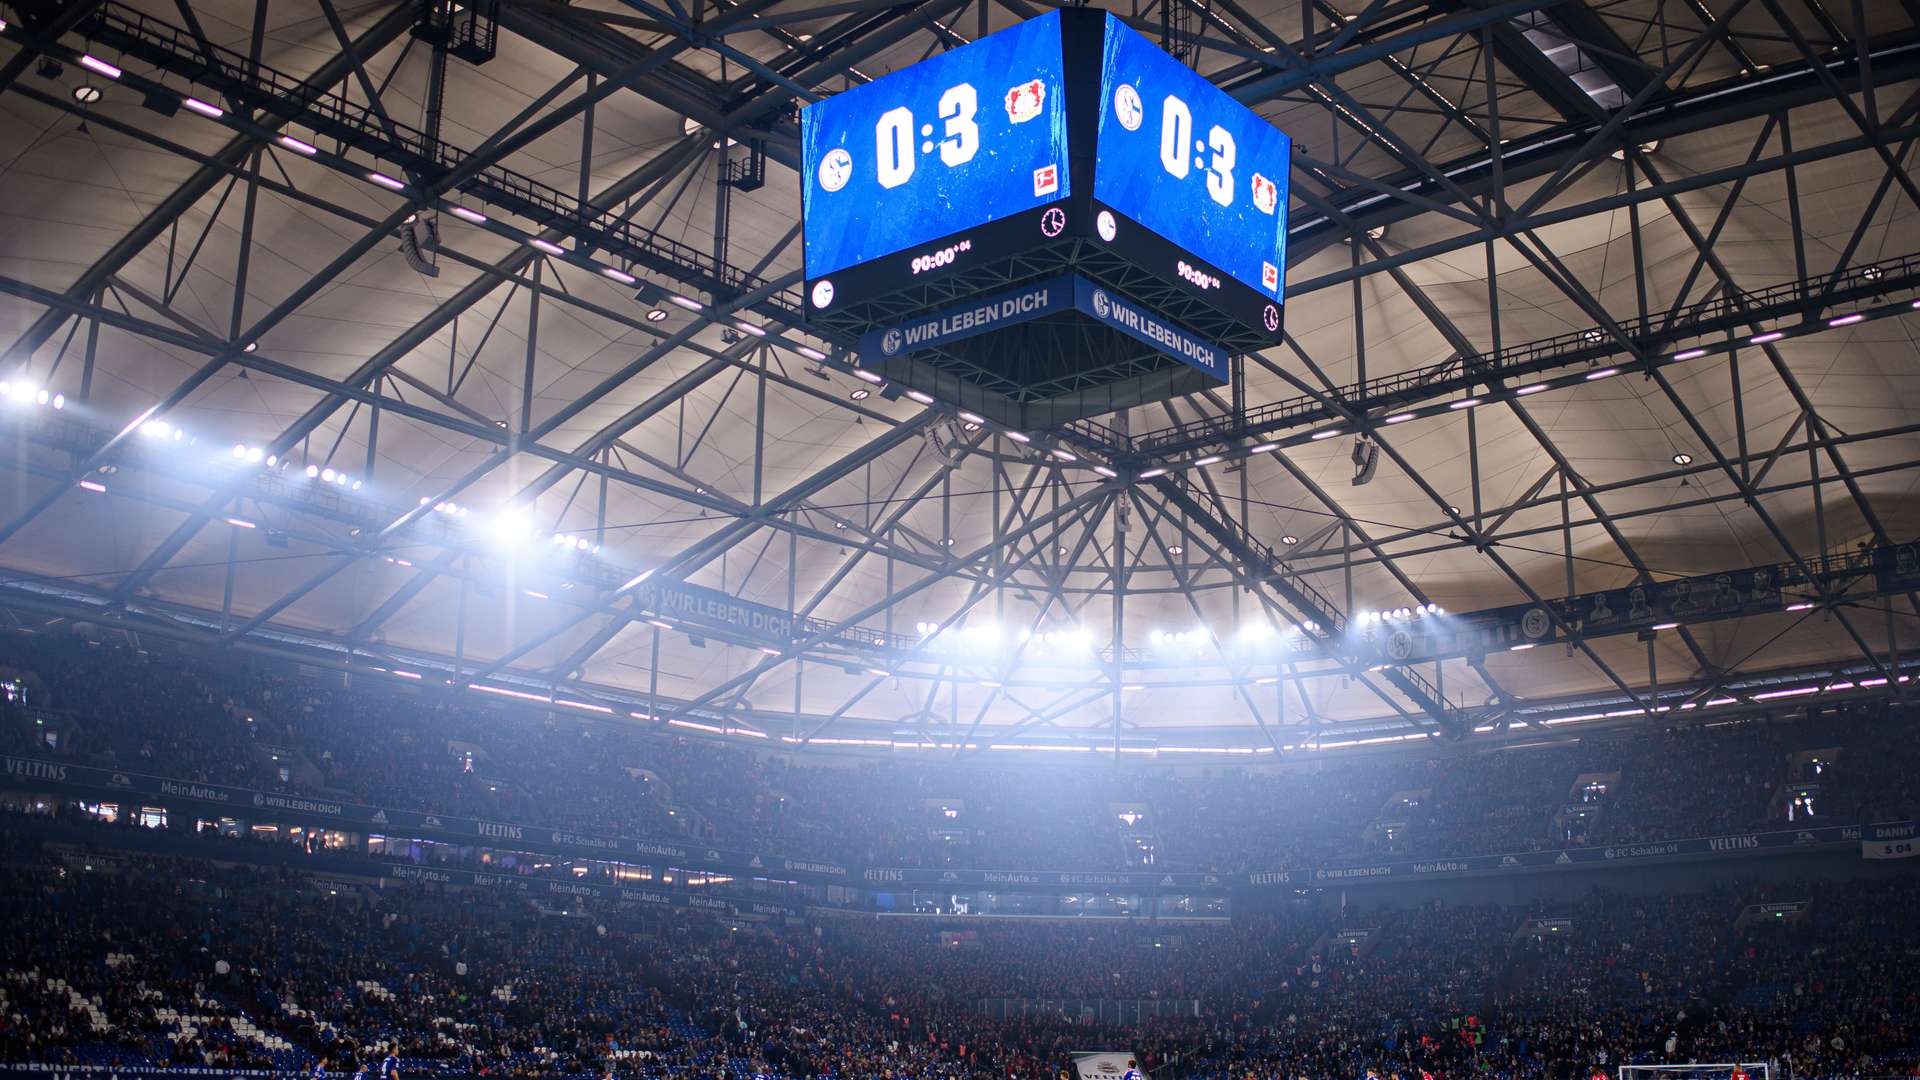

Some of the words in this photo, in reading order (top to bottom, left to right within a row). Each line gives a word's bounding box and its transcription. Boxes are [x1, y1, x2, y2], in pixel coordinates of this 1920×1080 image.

[905, 321, 939, 345] WIR
[942, 303, 999, 335] LEBEN
[1002, 289, 1048, 318] DICH
[1111, 301, 1138, 330] WIR
[1140, 316, 1181, 352] LEBEN
[1183, 338, 1214, 368] DICH
[660, 587, 695, 614] WIR
[697, 596, 750, 626] LEBEN
[752, 611, 791, 636] DICH
[6, 758, 67, 781] VELTINS
[161, 780, 229, 801] MeinAuto.de
[266, 796, 285, 808] WIR
[287, 799, 317, 812] LEBEN
[318, 804, 341, 815] DICH
[478, 822, 522, 839] VELTINS
[1710, 835, 1759, 851] VELTINS
[864, 869, 904, 881] VELTINS
[1250, 871, 1290, 884] VELTINS
